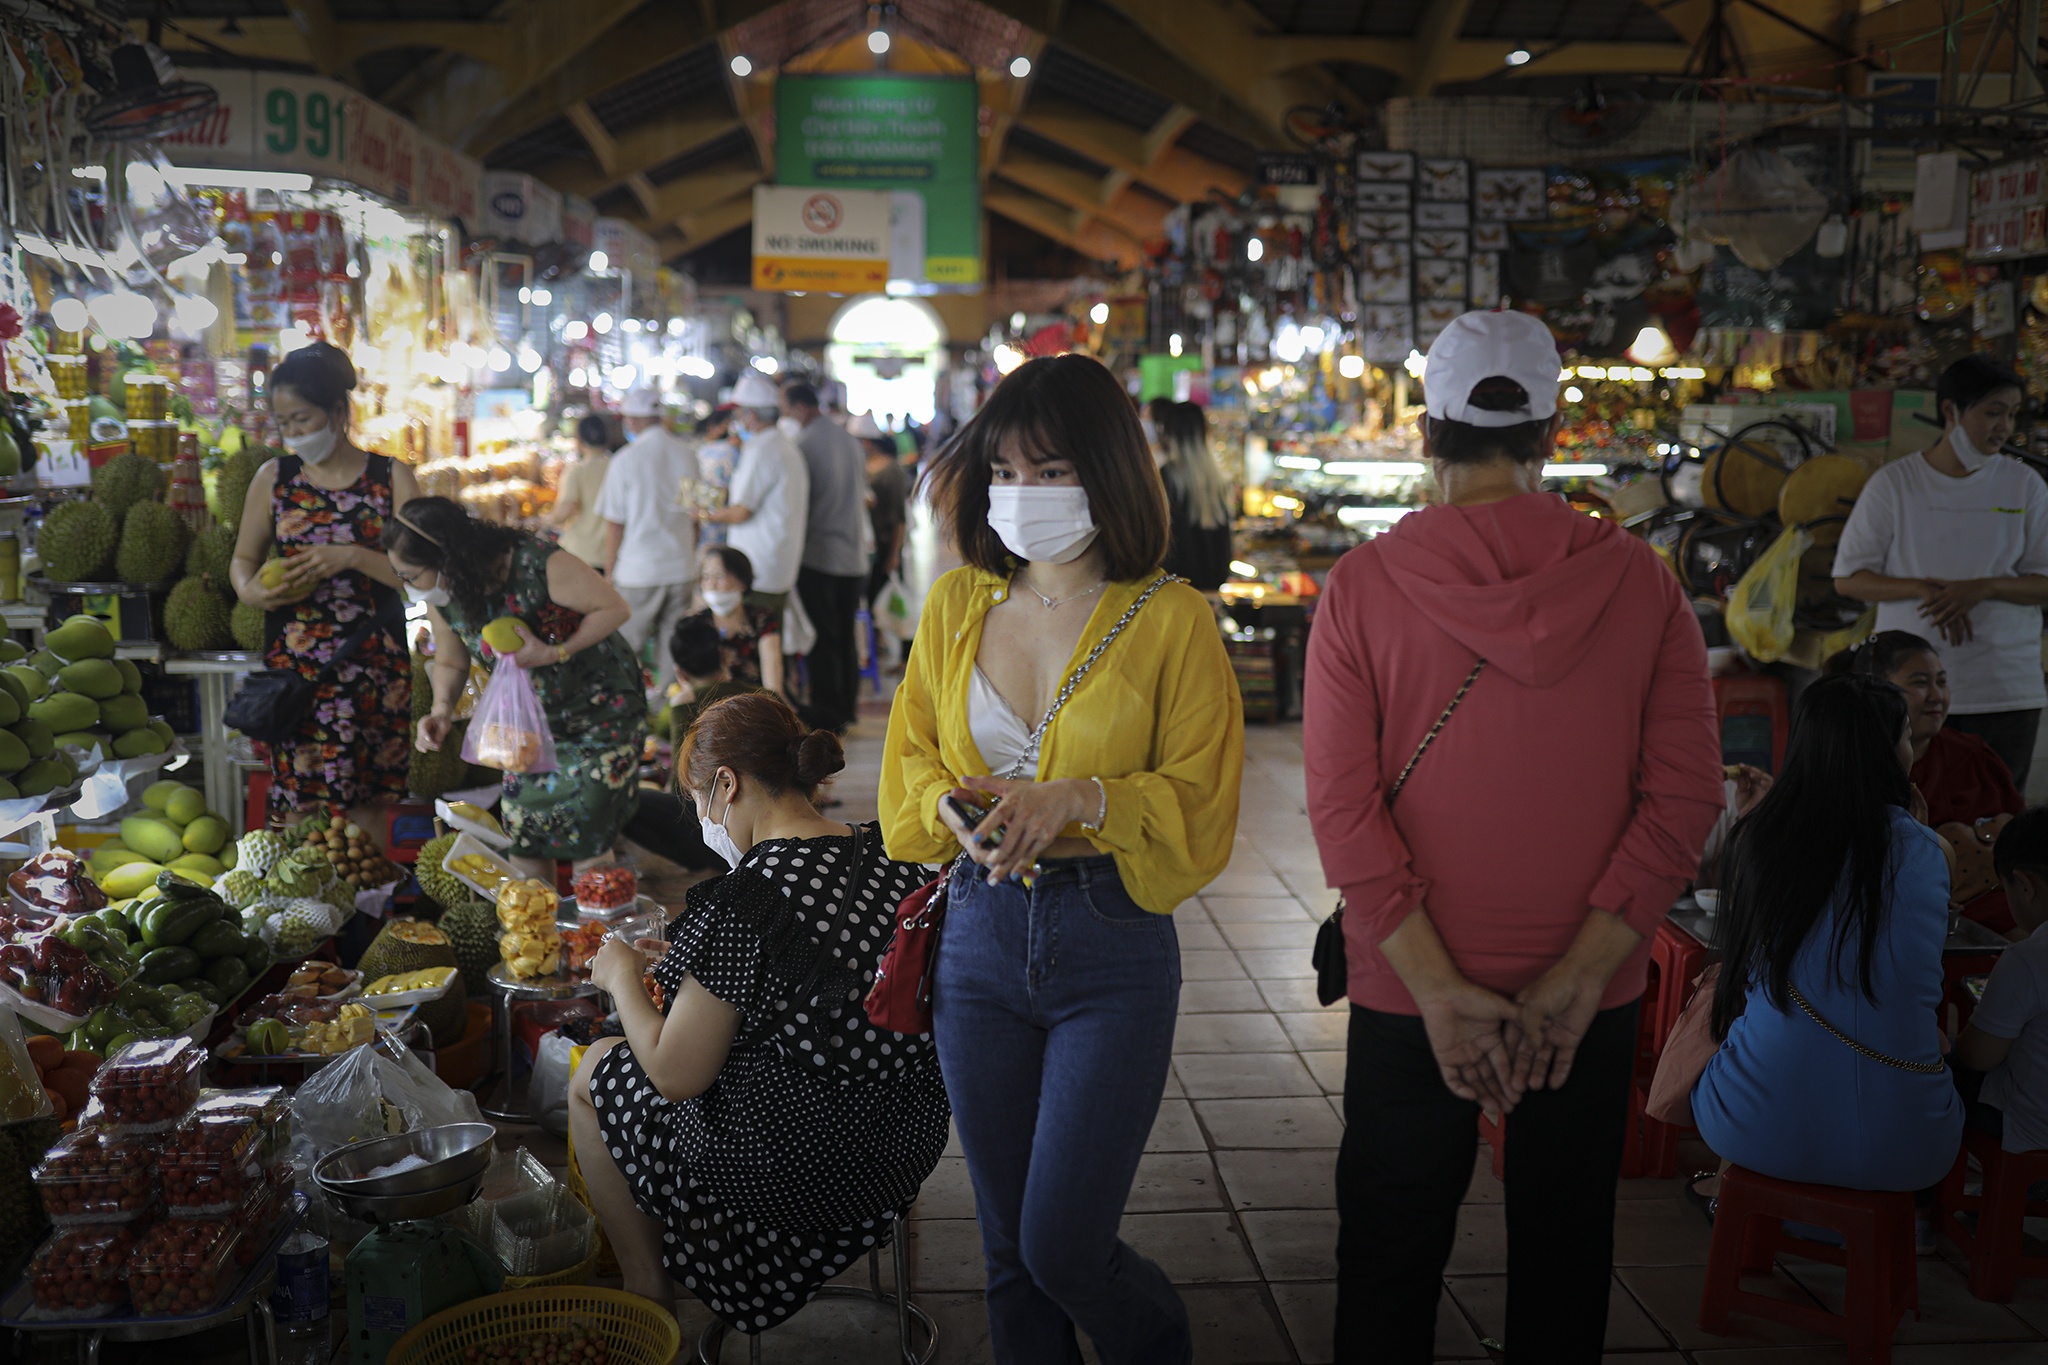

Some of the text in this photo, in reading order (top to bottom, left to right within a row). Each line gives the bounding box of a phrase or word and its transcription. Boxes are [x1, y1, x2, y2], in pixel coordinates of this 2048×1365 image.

[265, 88, 345, 162] 991
[765, 236, 880, 253] NO SMOKING
